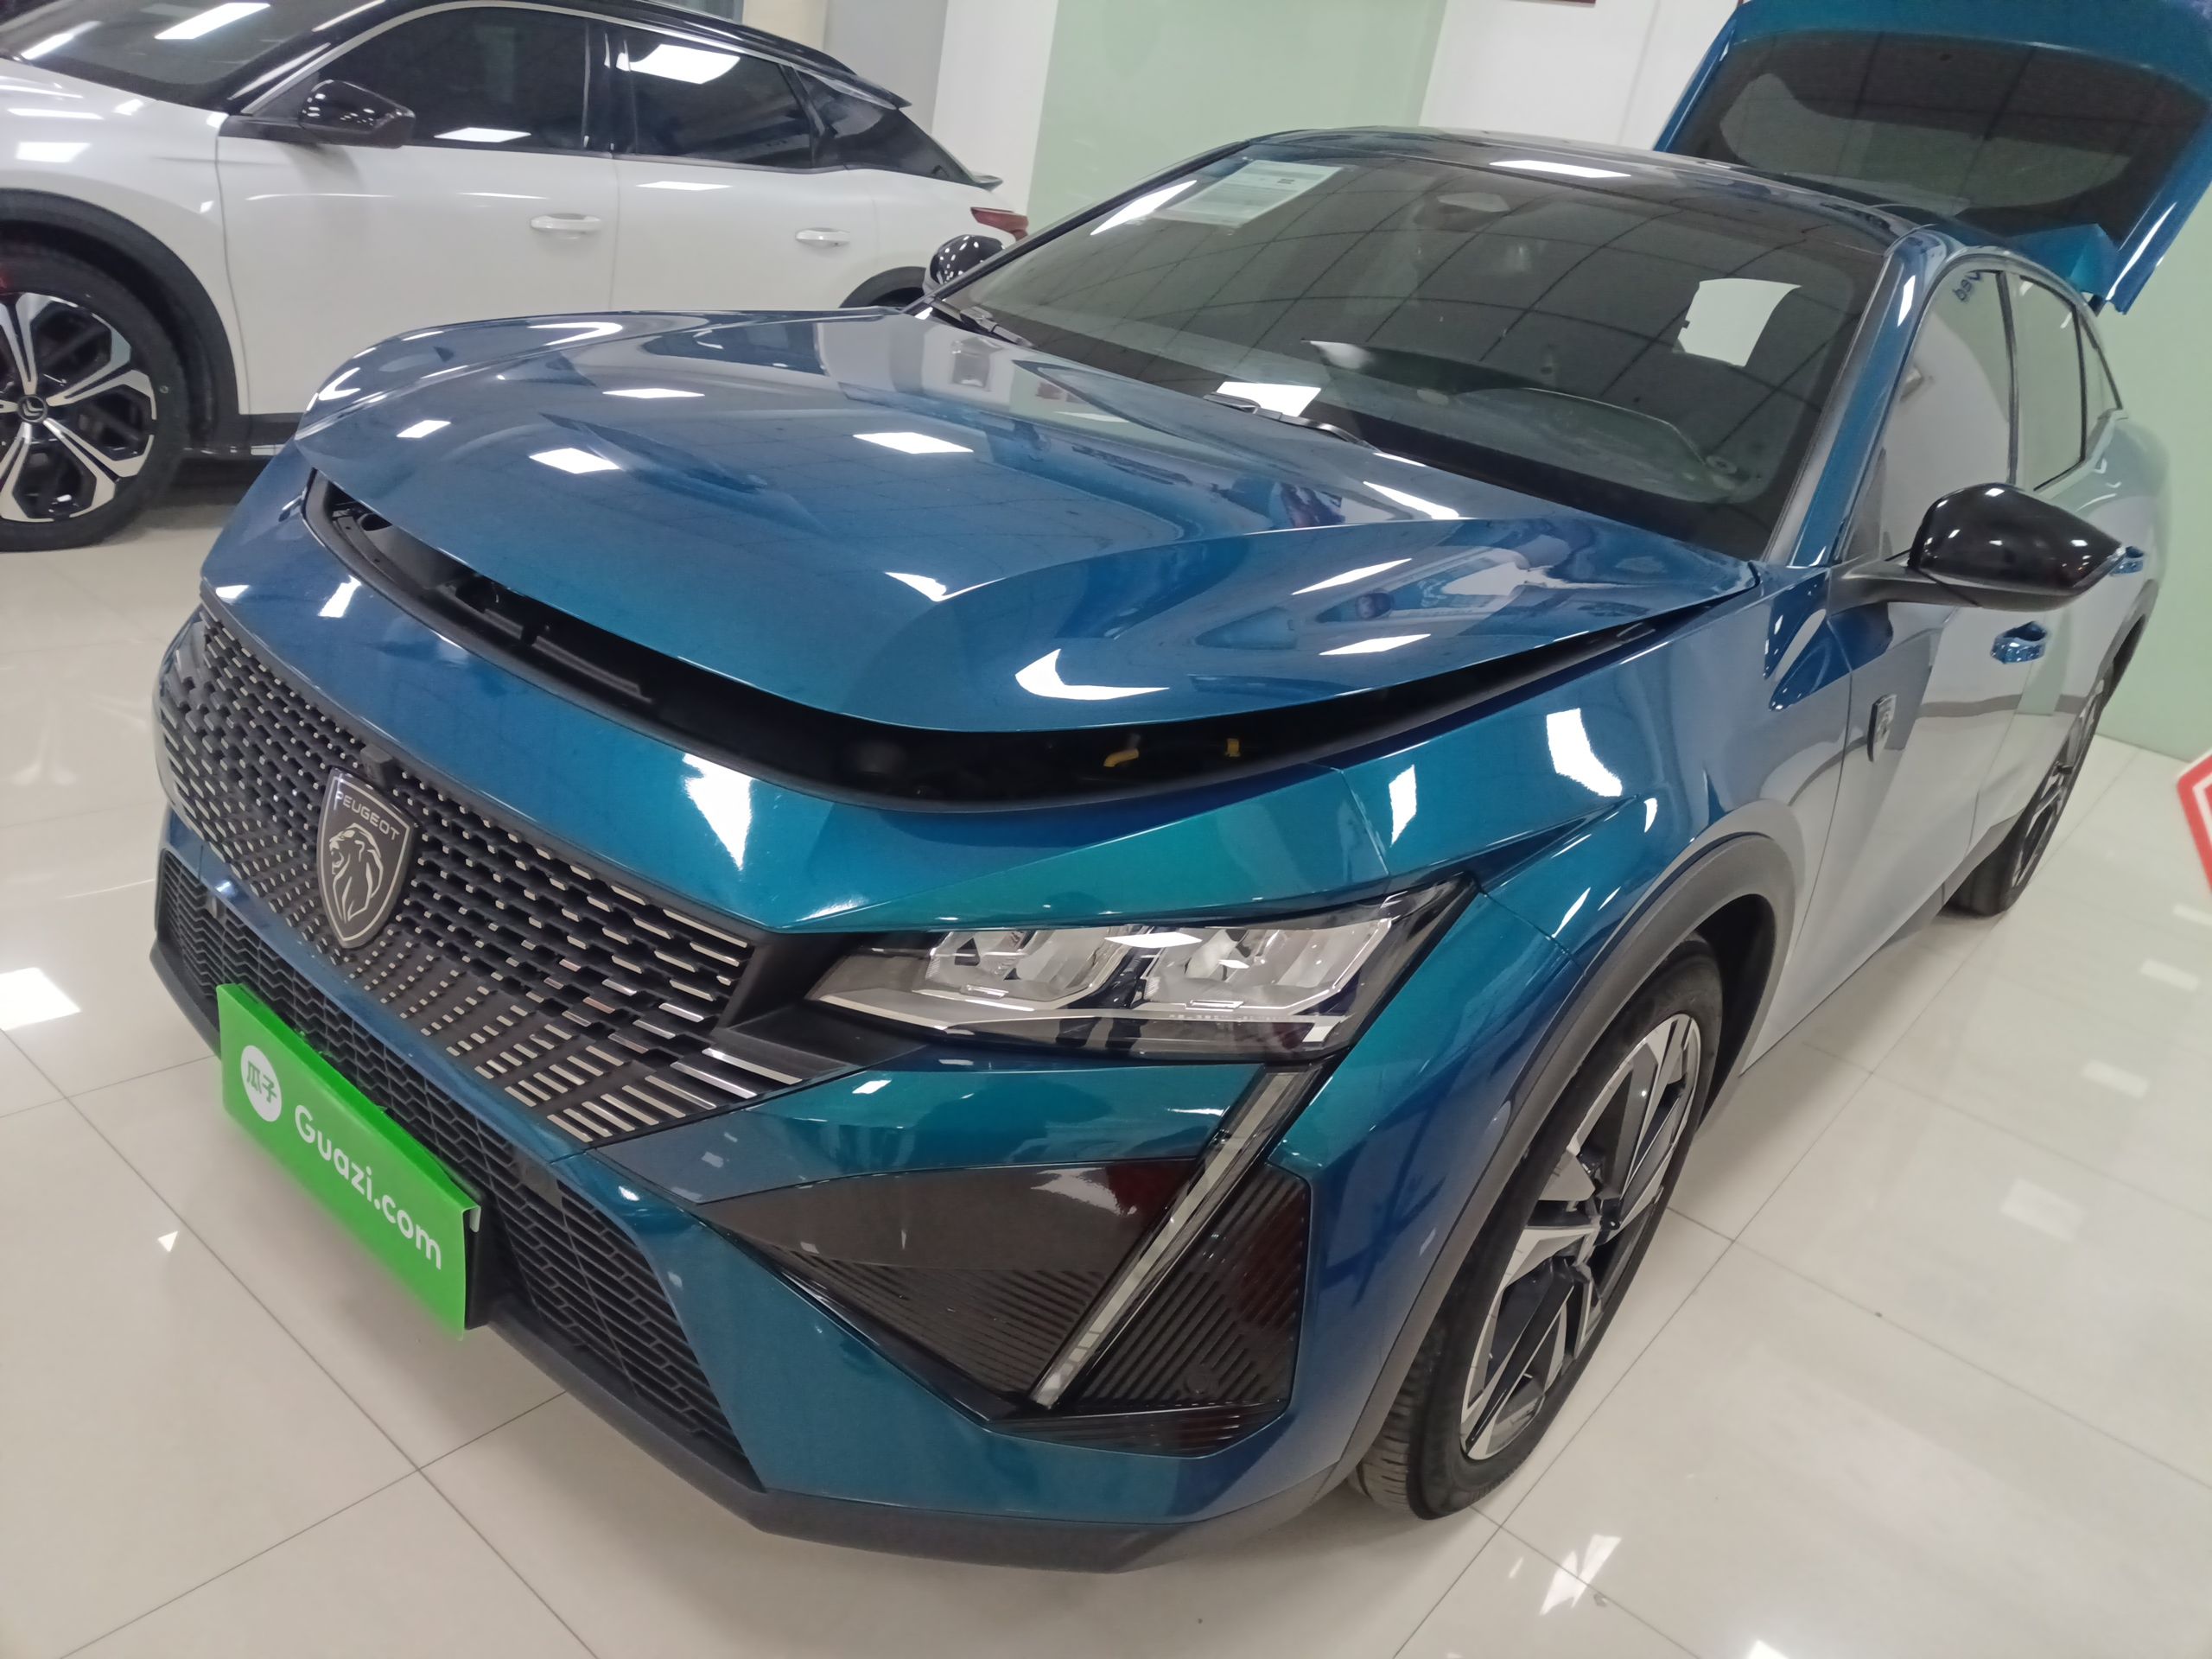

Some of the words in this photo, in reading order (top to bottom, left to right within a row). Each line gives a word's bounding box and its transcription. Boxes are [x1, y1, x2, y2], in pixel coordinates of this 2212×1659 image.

[334, 790, 400, 841] PEUGEOT
[246, 1060, 277, 1103] 瓜子
[295, 1104, 442, 1269] Guazi.com
